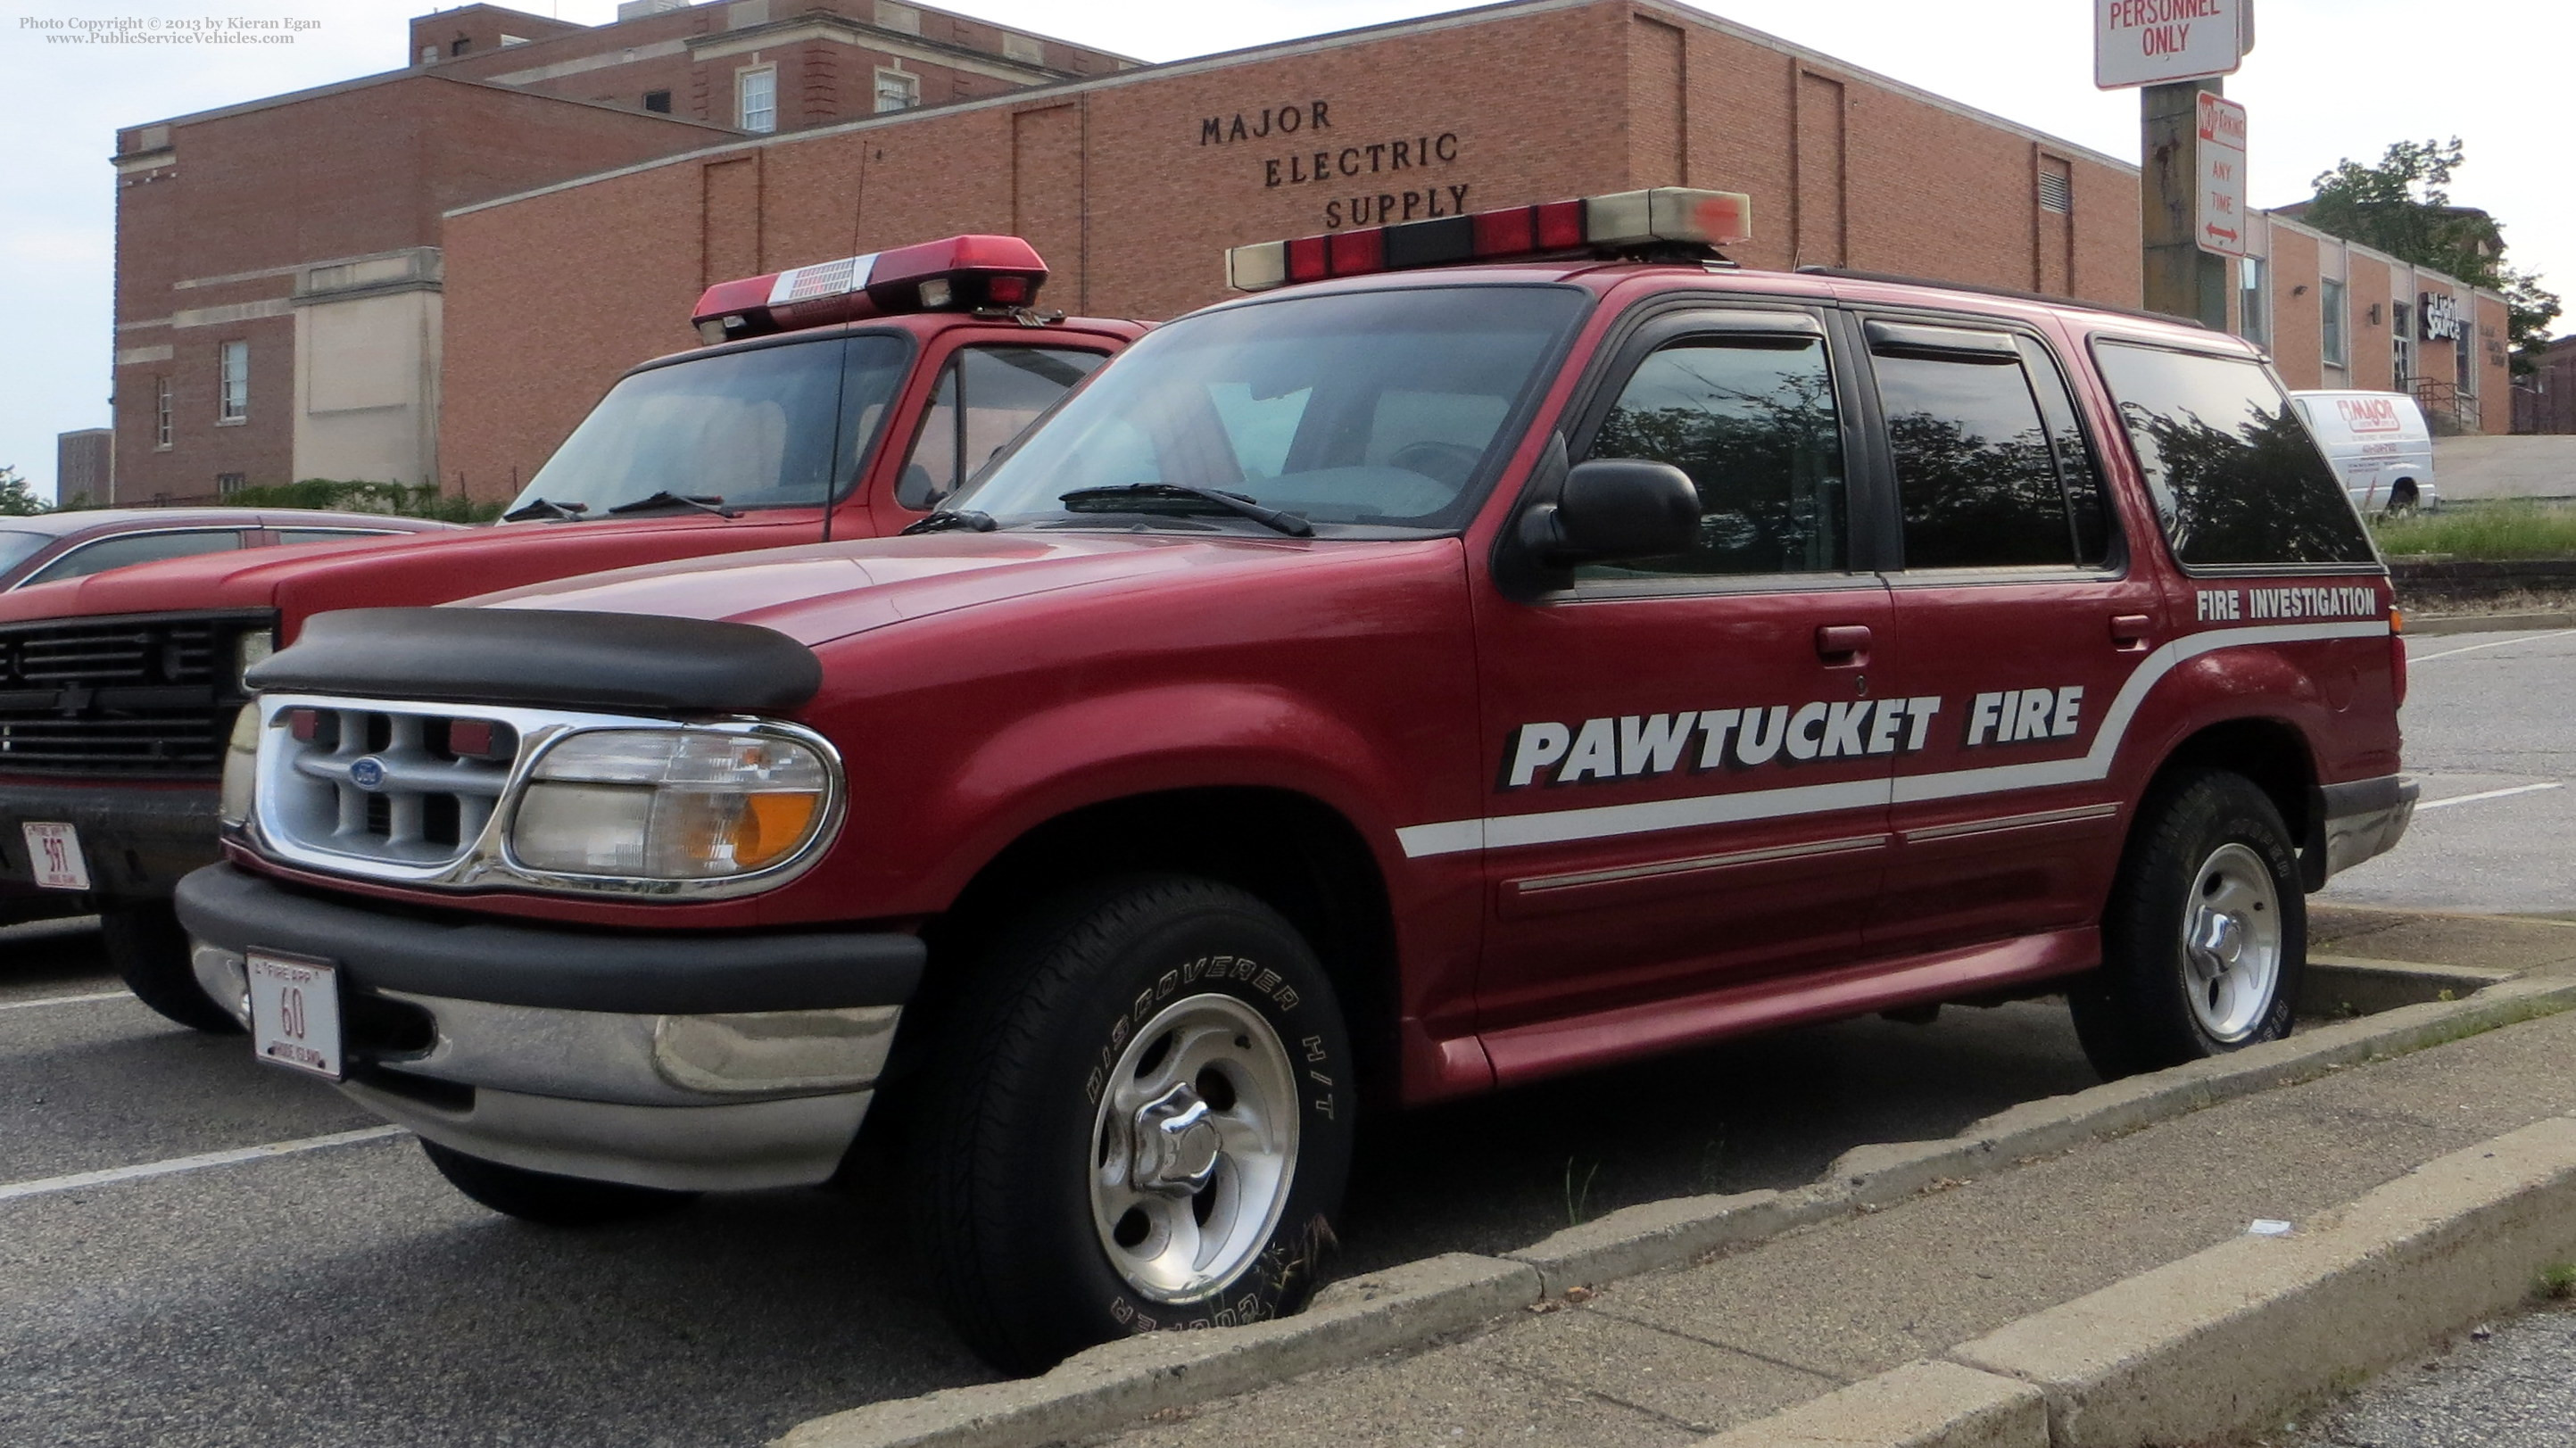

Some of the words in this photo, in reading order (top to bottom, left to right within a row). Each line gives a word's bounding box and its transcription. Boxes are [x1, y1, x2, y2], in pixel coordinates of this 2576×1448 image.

[2110, 0, 2222, 29] PERSONNEL
[2142, 23, 2191, 56] ONLY
[1199, 101, 1331, 146] MAJOR
[1264, 133, 1458, 187] ELECTRIC
[2212, 160, 2232, 182] ANY
[1325, 183, 1469, 229] SUPPLY
[2211, 190, 2233, 215] TIME
[2427, 303, 2461, 340] Source
[2434, 293, 2459, 323] Light
[2197, 589, 2241, 621] FIRE
[2249, 587, 2377, 618] INVESTIGATION
[1506, 695, 1942, 788] PAWTUCKET
[1966, 685, 2084, 746] FIRE
[43, 838, 69, 873] 597
[268, 964, 289, 980] FIRE
[291, 969, 311, 984] APP
[282, 986, 306, 1039] 60
[1086, 955, 1300, 1106] DISCOVERER
[1302, 1035, 1336, 1121] H/T
